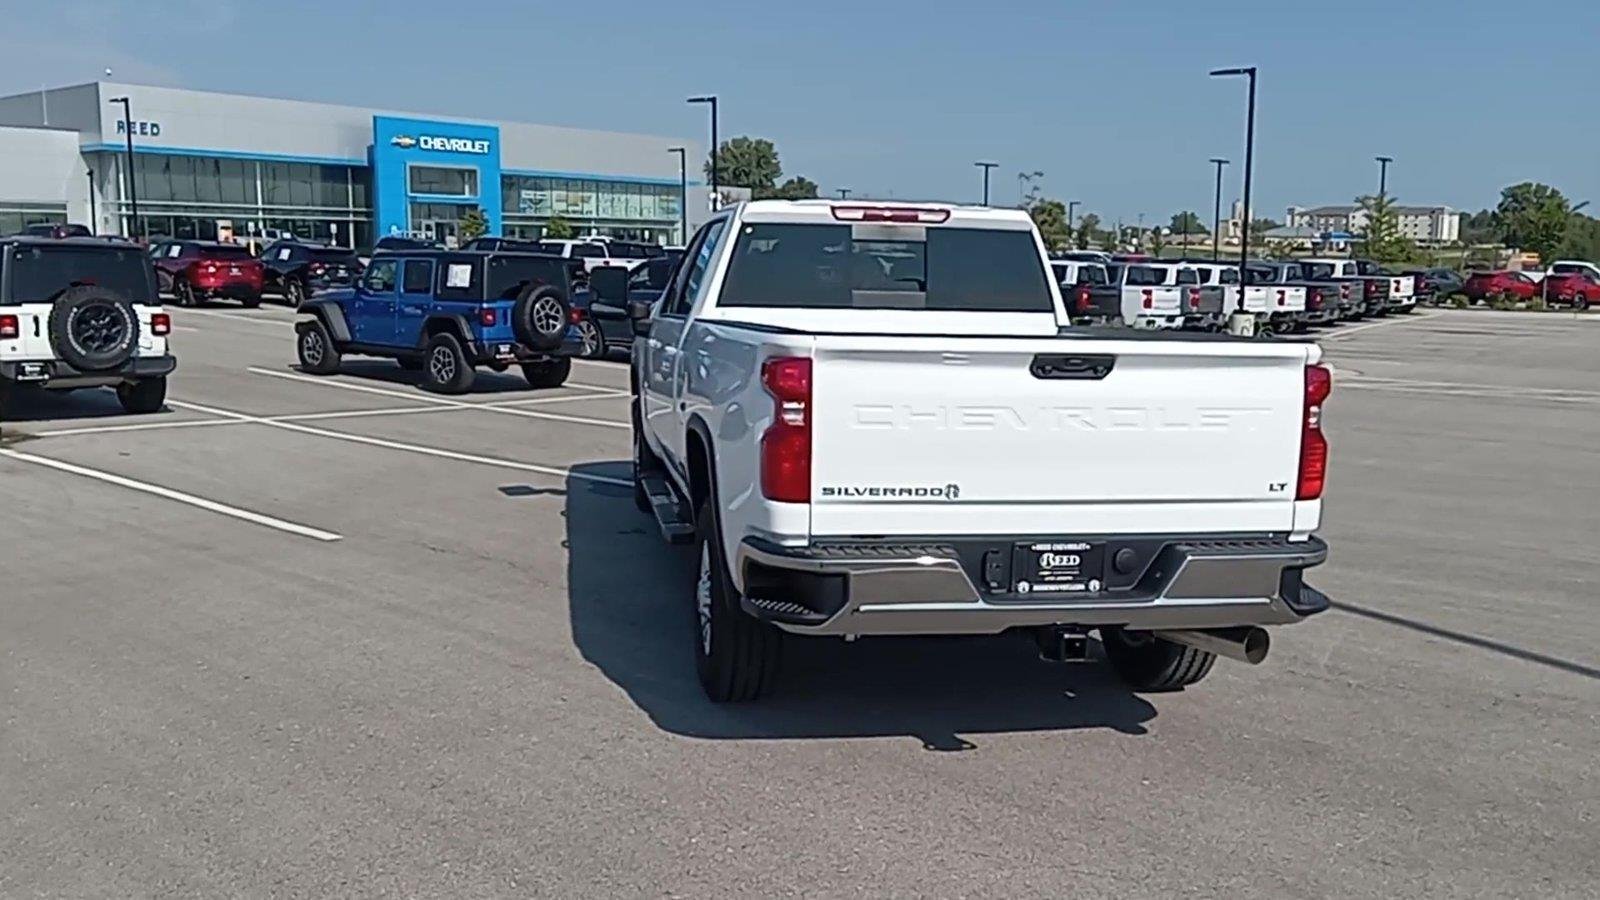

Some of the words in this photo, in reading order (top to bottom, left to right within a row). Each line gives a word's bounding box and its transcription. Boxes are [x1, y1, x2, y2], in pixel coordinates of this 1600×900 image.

[116, 120, 160, 136] REED
[420, 136, 490, 154] CHEVROLET
[852, 404, 1273, 432] CHEVROLET
[822, 486, 943, 497] SILVERADO
[1269, 482, 1288, 492] LT
